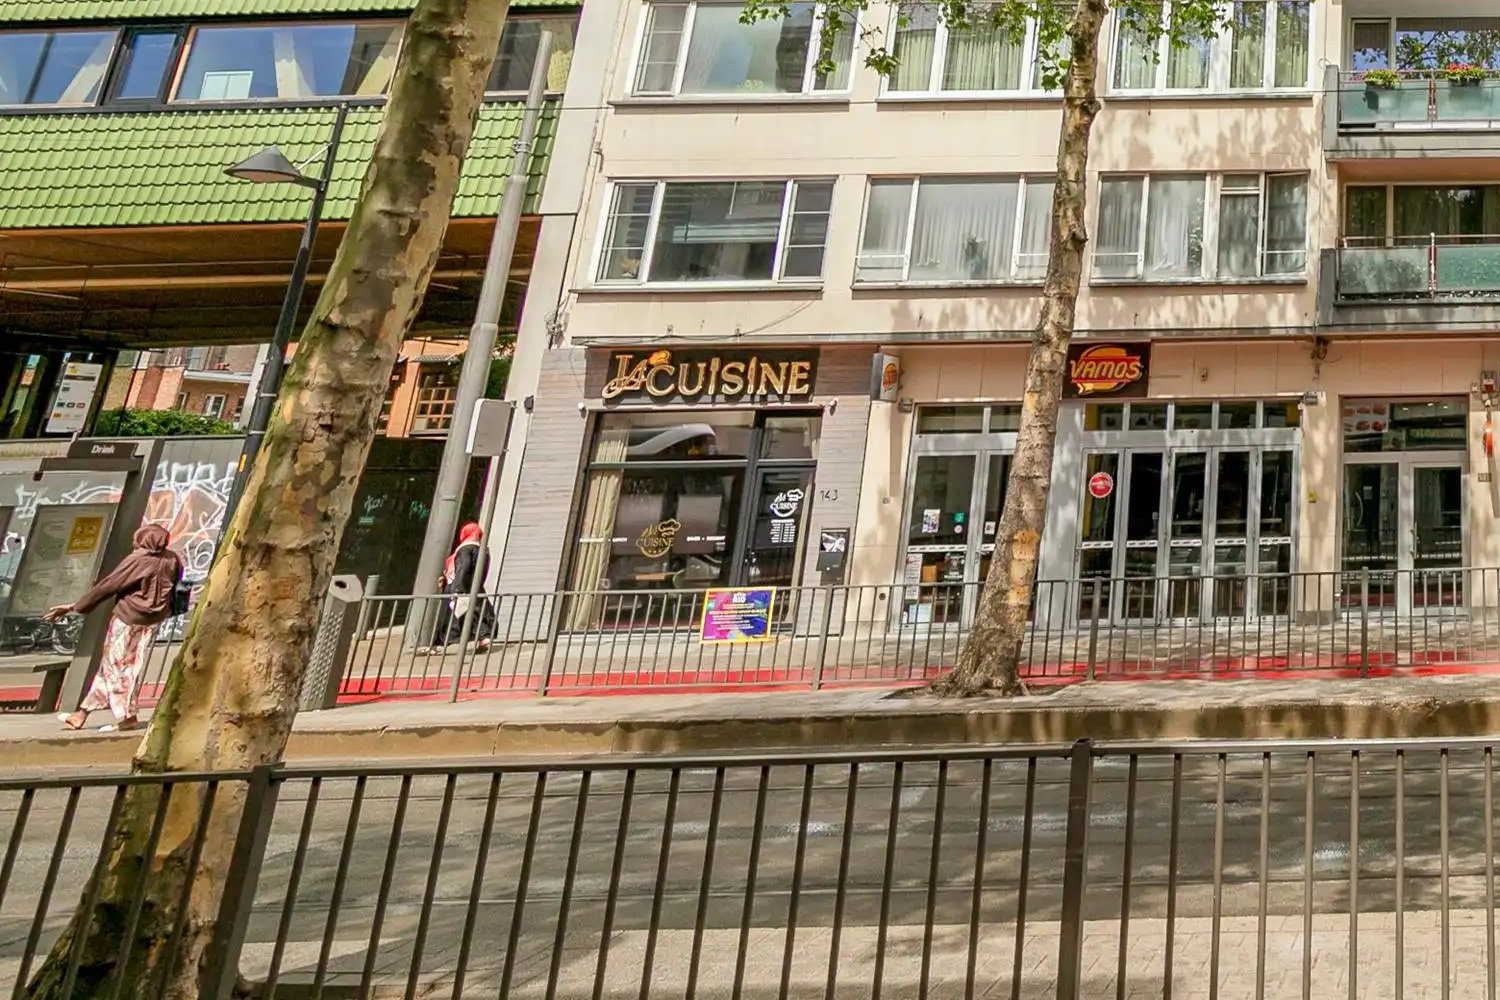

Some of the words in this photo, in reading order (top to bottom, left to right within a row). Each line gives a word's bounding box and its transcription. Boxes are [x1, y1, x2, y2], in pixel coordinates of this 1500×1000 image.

[646, 356, 810, 396] CUISINE
[1071, 360, 1143, 379] VAMOS
[91, 444, 115, 454] Drink
